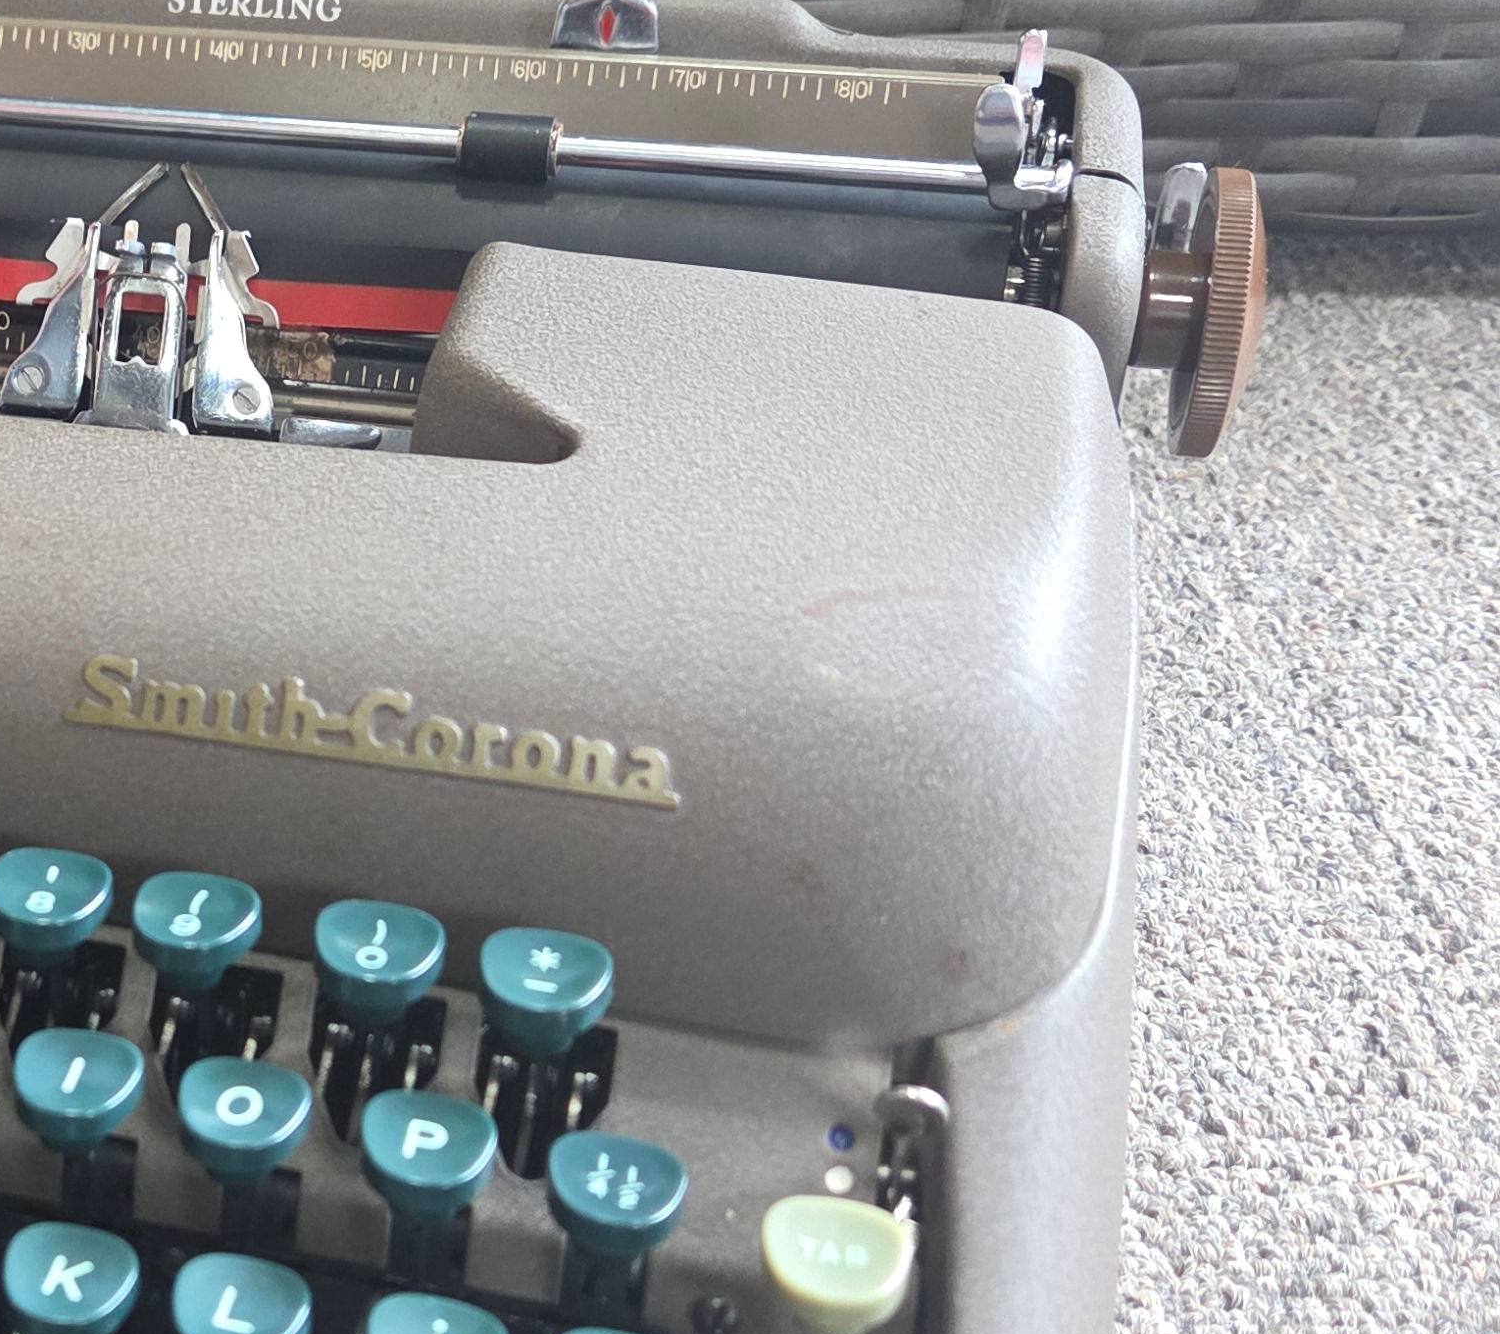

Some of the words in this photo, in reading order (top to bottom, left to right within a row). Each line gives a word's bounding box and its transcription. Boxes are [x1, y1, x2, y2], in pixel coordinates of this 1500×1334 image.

[71, 30, 98, 51] 30
[213, 40, 241, 62] 40
[360, 49, 389, 71] 50
[513, 59, 542, 81] 60
[673, 69, 703, 90] 70
[837, 79, 869, 100] 80
[63, 654, 681, 808] Smith-Corona
[25, 890, 56, 914] 8
[168, 912, 202, 937] 9
[60, 1056, 86, 1094] I
[214, 1085, 264, 1127] O
[400, 1118, 449, 1160] P
[798, 1234, 869, 1268] TAB
[40, 1254, 94, 1303] K
[210, 1284, 255, 1334] L
